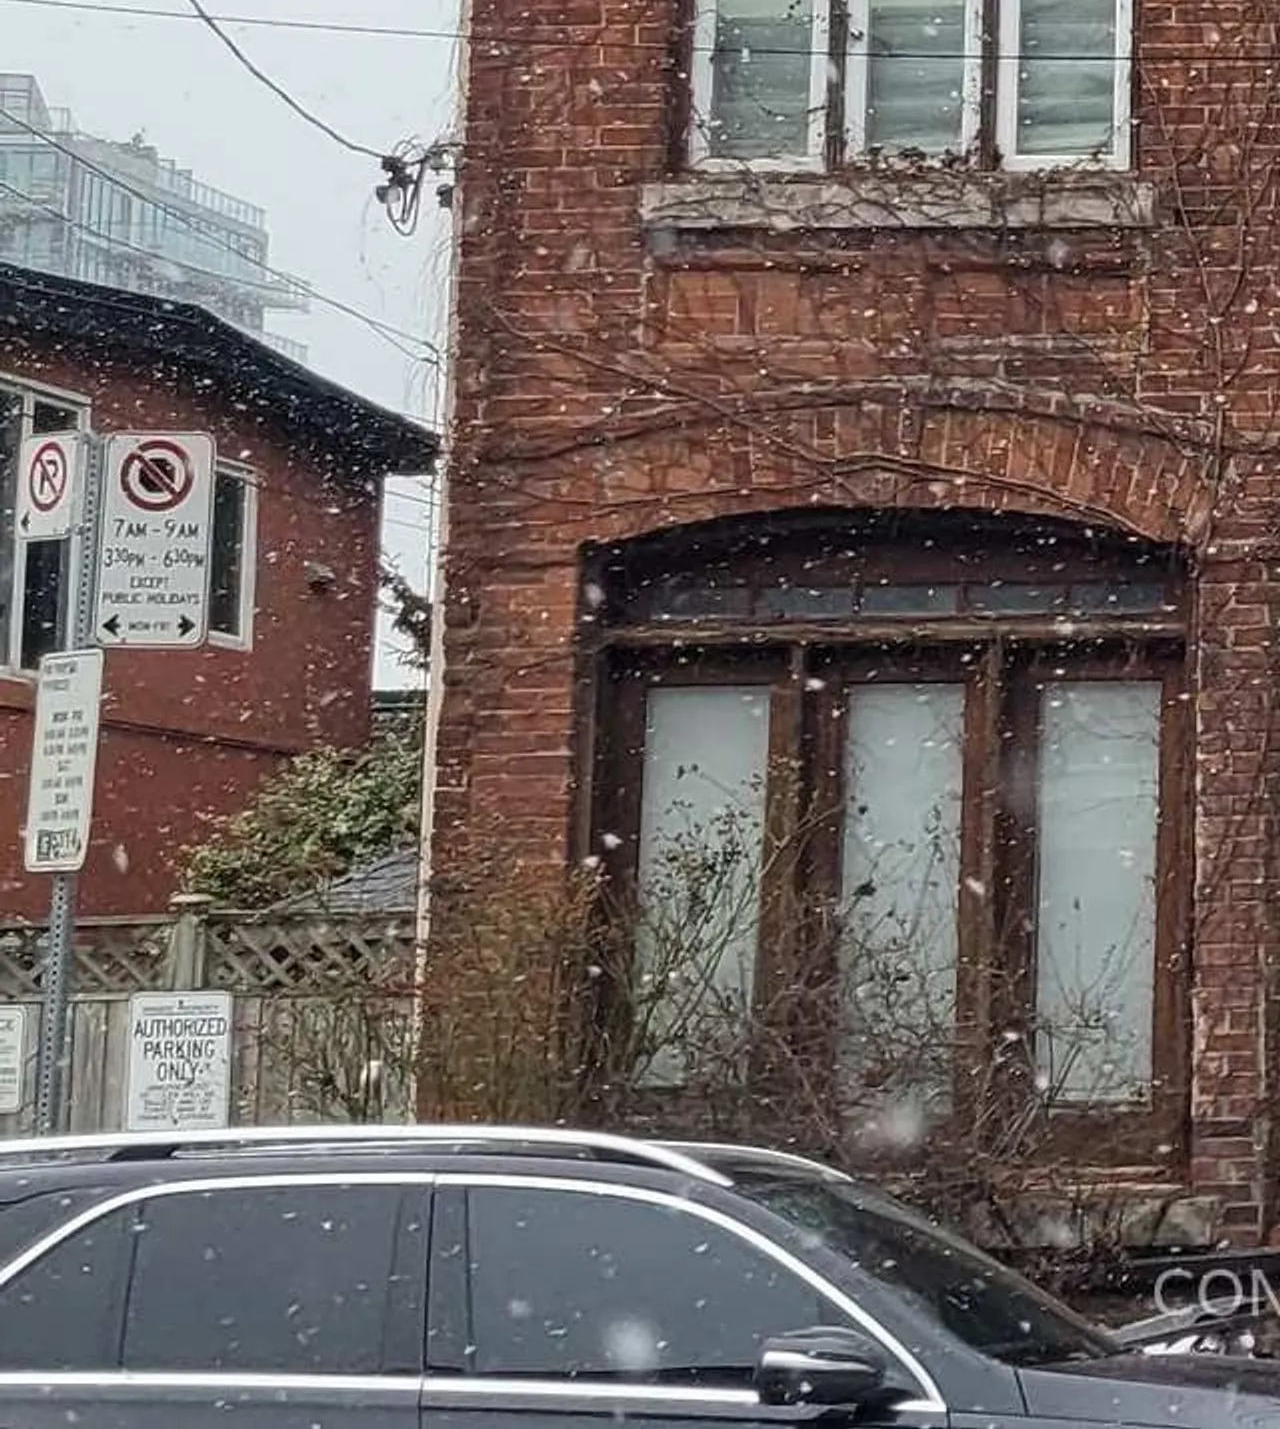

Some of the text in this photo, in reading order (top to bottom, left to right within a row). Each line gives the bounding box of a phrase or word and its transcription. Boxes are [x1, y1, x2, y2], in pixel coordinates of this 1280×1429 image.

[134, 1017, 227, 1039] AUTHORIZED
[143, 1039, 216, 1060] PARKING
[156, 1062, 200, 1083] ONLY
